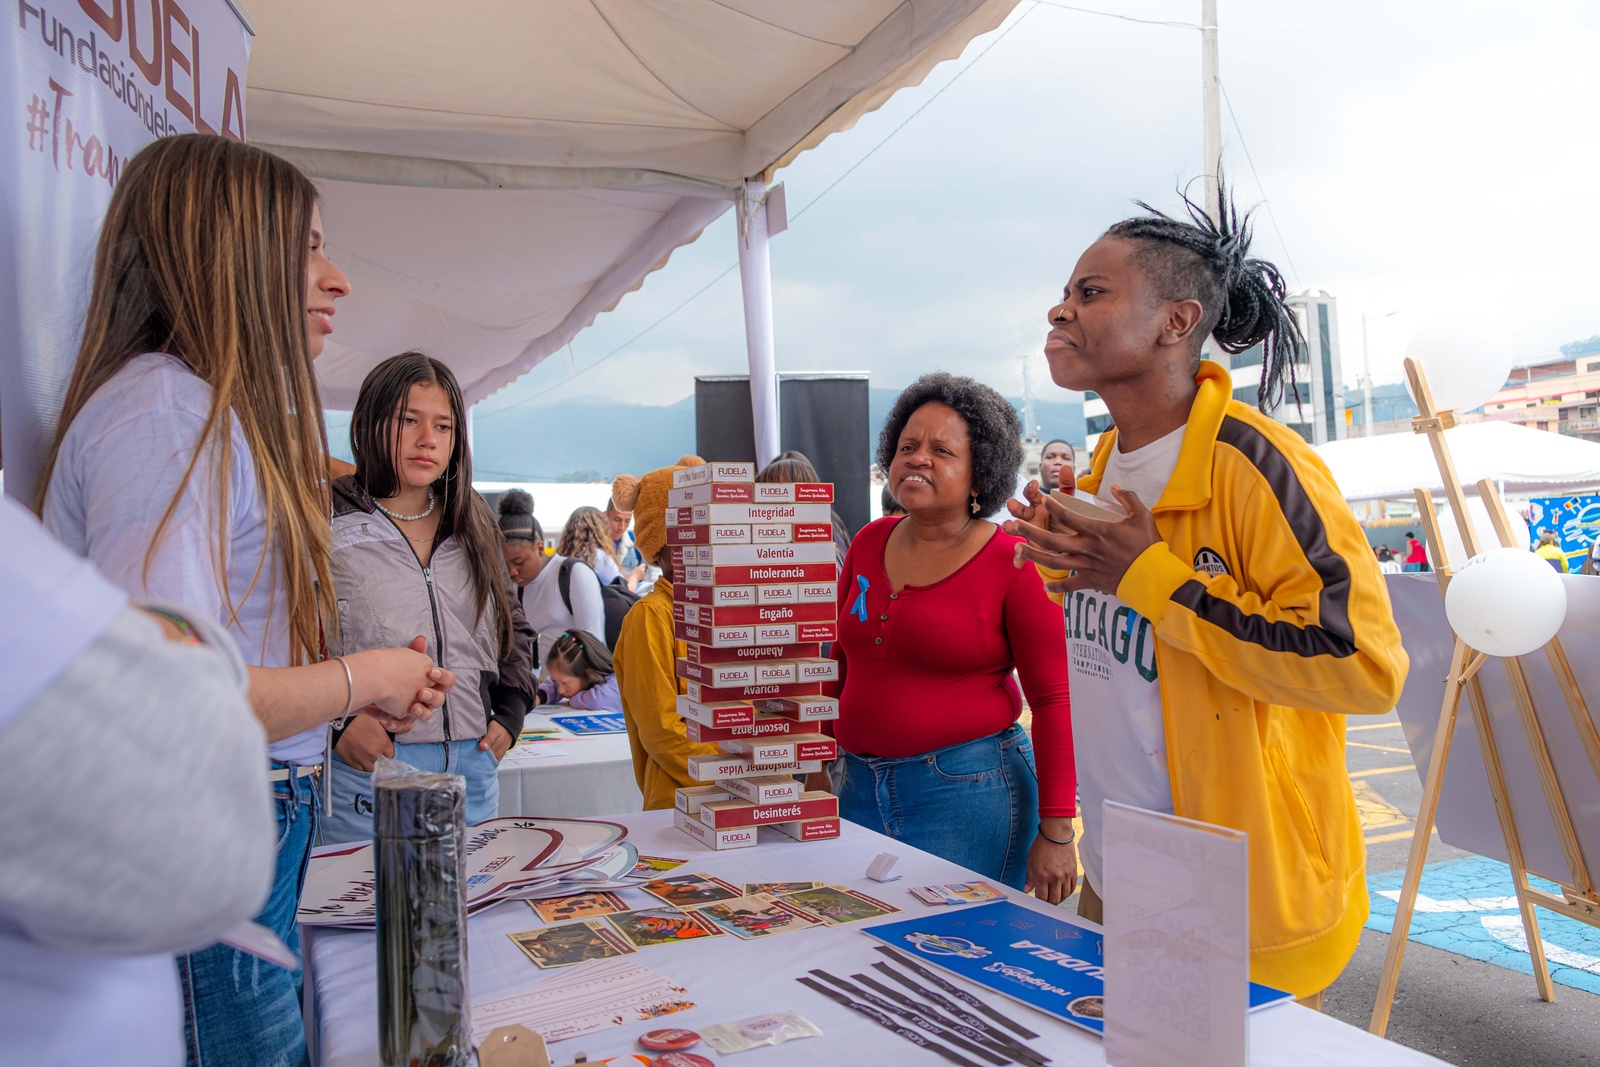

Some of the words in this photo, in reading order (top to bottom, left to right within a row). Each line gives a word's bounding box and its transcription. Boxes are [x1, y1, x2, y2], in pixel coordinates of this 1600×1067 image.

[718, 467, 747, 475] FUDELA
[748, 507, 795, 520] Integridad
[756, 548, 794, 558] Valentía
[1195, 564, 1224, 572] ENTUS
[750, 567, 804, 579] Intolerancia
[720, 590, 749, 599] FUDELA
[764, 589, 792, 597] FUDELA
[804, 588, 832, 596] FUDELA
[760, 608, 793, 621] Engaño
[719, 632, 748, 640] FUDELA
[738, 646, 784, 658] Abandono
[762, 669, 790, 677] FUDELA
[804, 667, 832, 675] FUDELA
[720, 672, 748, 680] FUDELA
[744, 685, 780, 696] Avaricia
[806, 706, 832, 714] FUDELA
[732, 723, 790, 735] Desconfianza
[760, 749, 788, 758] FUDELA
[718, 765, 744, 776] Vidas
[746, 762, 802, 773] Transformar
[764, 788, 792, 797] FUDELA
[753, 806, 802, 820] Desinterés
[722, 833, 750, 842] FUDELA
[897, 1026, 928, 1047] FUDELA
